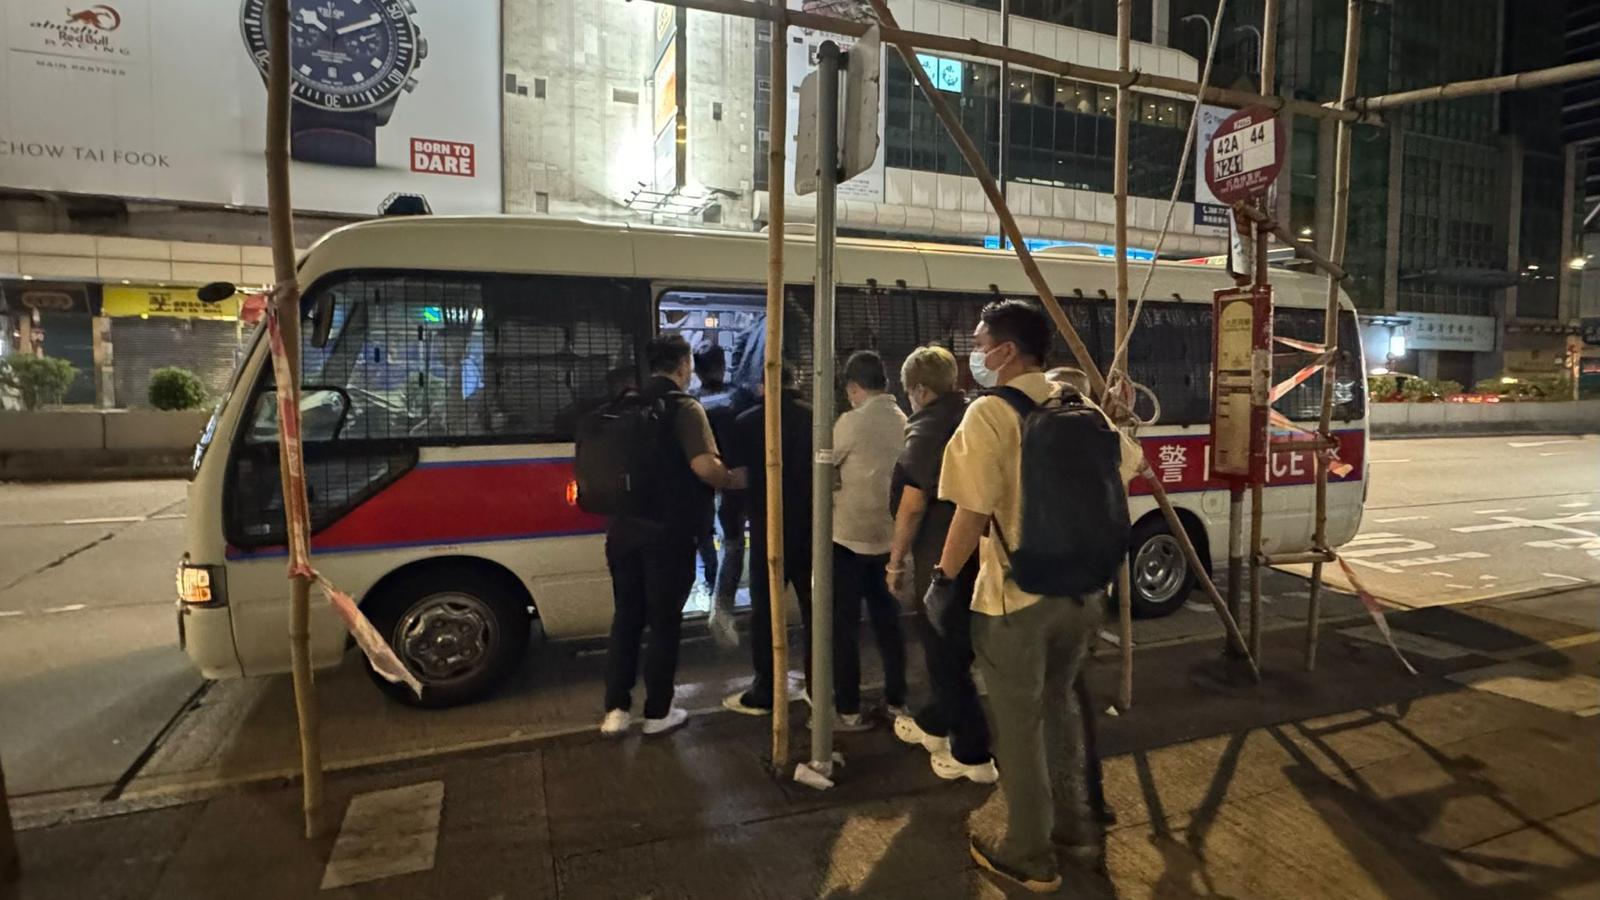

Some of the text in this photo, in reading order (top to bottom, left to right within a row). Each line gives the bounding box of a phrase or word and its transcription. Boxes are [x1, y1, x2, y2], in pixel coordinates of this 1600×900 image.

[59, 31, 109, 46] Red Bull
[36, 59, 67, 69] MAIN
[324, 94, 341, 108] 30
[414, 140, 471, 157] BORN TO
[1216, 124, 1265, 156] 42A 44
[72, 145, 105, 162] TAI
[113, 149, 170, 168] FOOK
[414, 153, 472, 175] DARE
[1215, 154, 1242, 180] N241
[1158, 444, 1188, 483] 警
